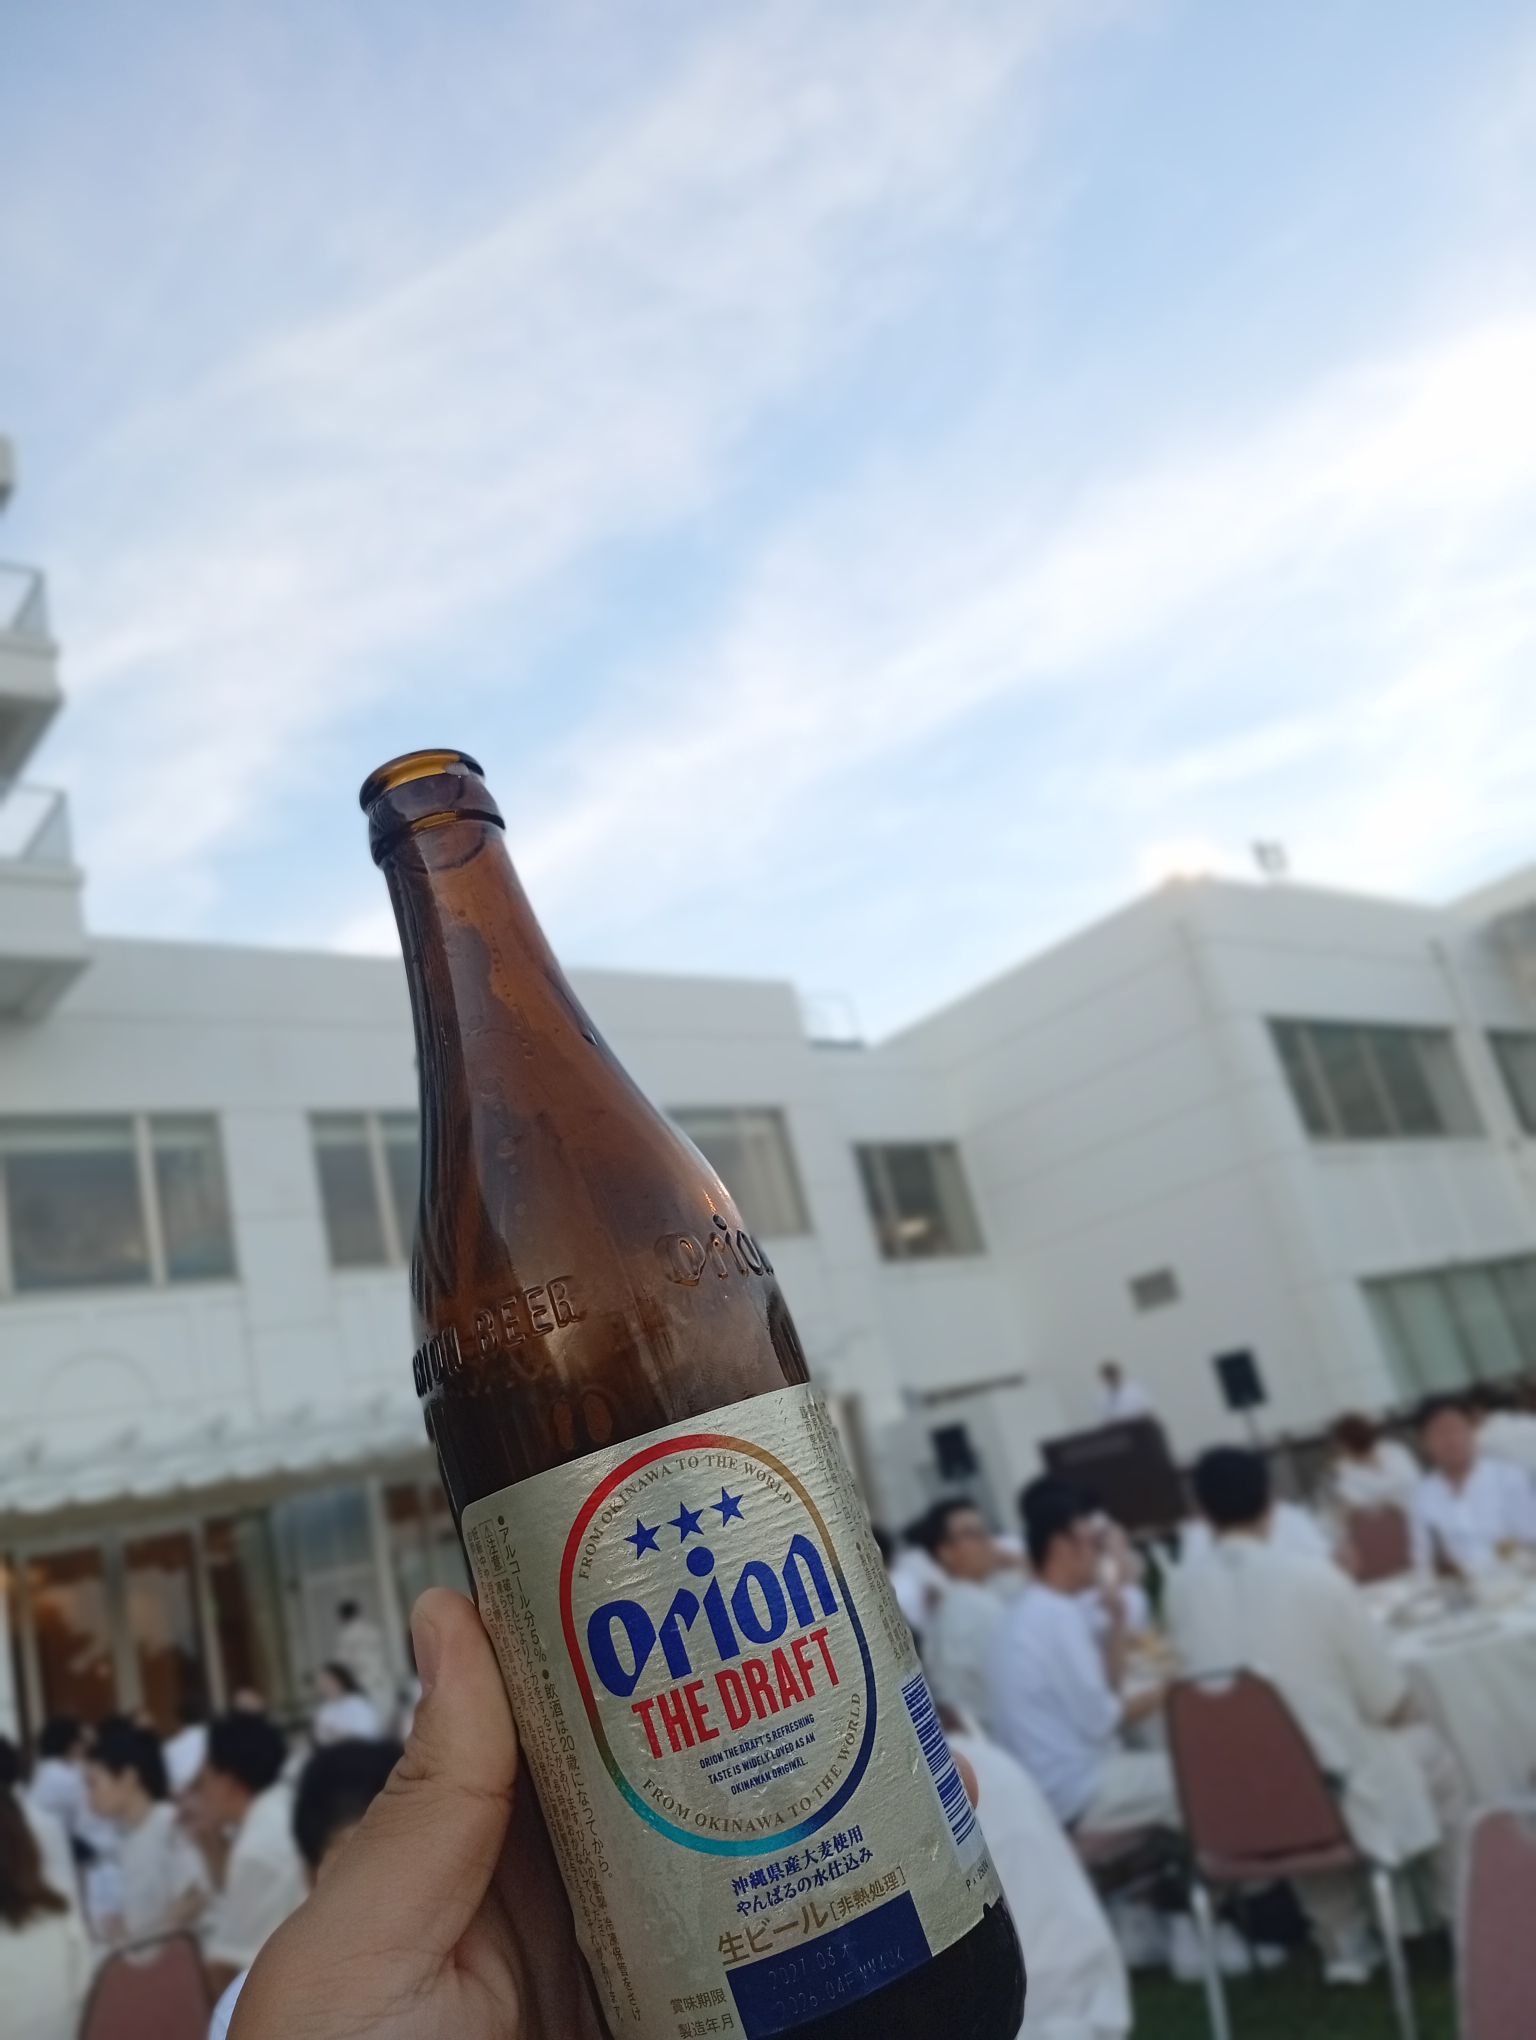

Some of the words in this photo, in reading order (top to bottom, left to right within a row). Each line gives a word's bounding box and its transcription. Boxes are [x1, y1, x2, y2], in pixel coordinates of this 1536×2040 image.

[475, 1275, 586, 1360] BEER
[579, 1527, 604, 1580] FROM
[601, 1464, 672, 1525] OKINAWA
[676, 1455, 700, 1471] TO
[704, 1454, 738, 1471] THE
[744, 1461, 793, 1504] WORLD
[587, 1533, 839, 1698] Orion
[631, 1680, 720, 1760] THE
[714, 1627, 840, 1730] DRAFT
[642, 1778, 690, 1820] FROM
[694, 1812, 785, 1833] OKINAWA
[788, 1797, 812, 1818] TO
[811, 1764, 842, 1800] THE
[837, 1692, 862, 1762] WORLD
[699, 1751, 724, 1769] ORION
[724, 1746, 740, 1760] THE
[739, 1732, 772, 1754] DRAFT'S
[771, 1713, 815, 1741] REFRESHING
[708, 1768, 733, 1785] TASTE
[733, 1764, 742, 1776] IS
[741, 1753, 772, 1771] WIDELY
[771, 1743, 795, 1760] LOVED
[795, 1737, 805, 1750] AS
[805, 1732, 816, 1745] AN
[730, 1771, 772, 1796] OKINAWAN
[771, 1756, 809, 1779] ORIGINAL.
[731, 1824, 864, 1897] 沖縄県産大麦使用
[736, 1846, 874, 1917] やんばるの水仕込み
[670, 1987, 728, 2016] 賞味期限
[678, 2012, 736, 2040] 製造年月
